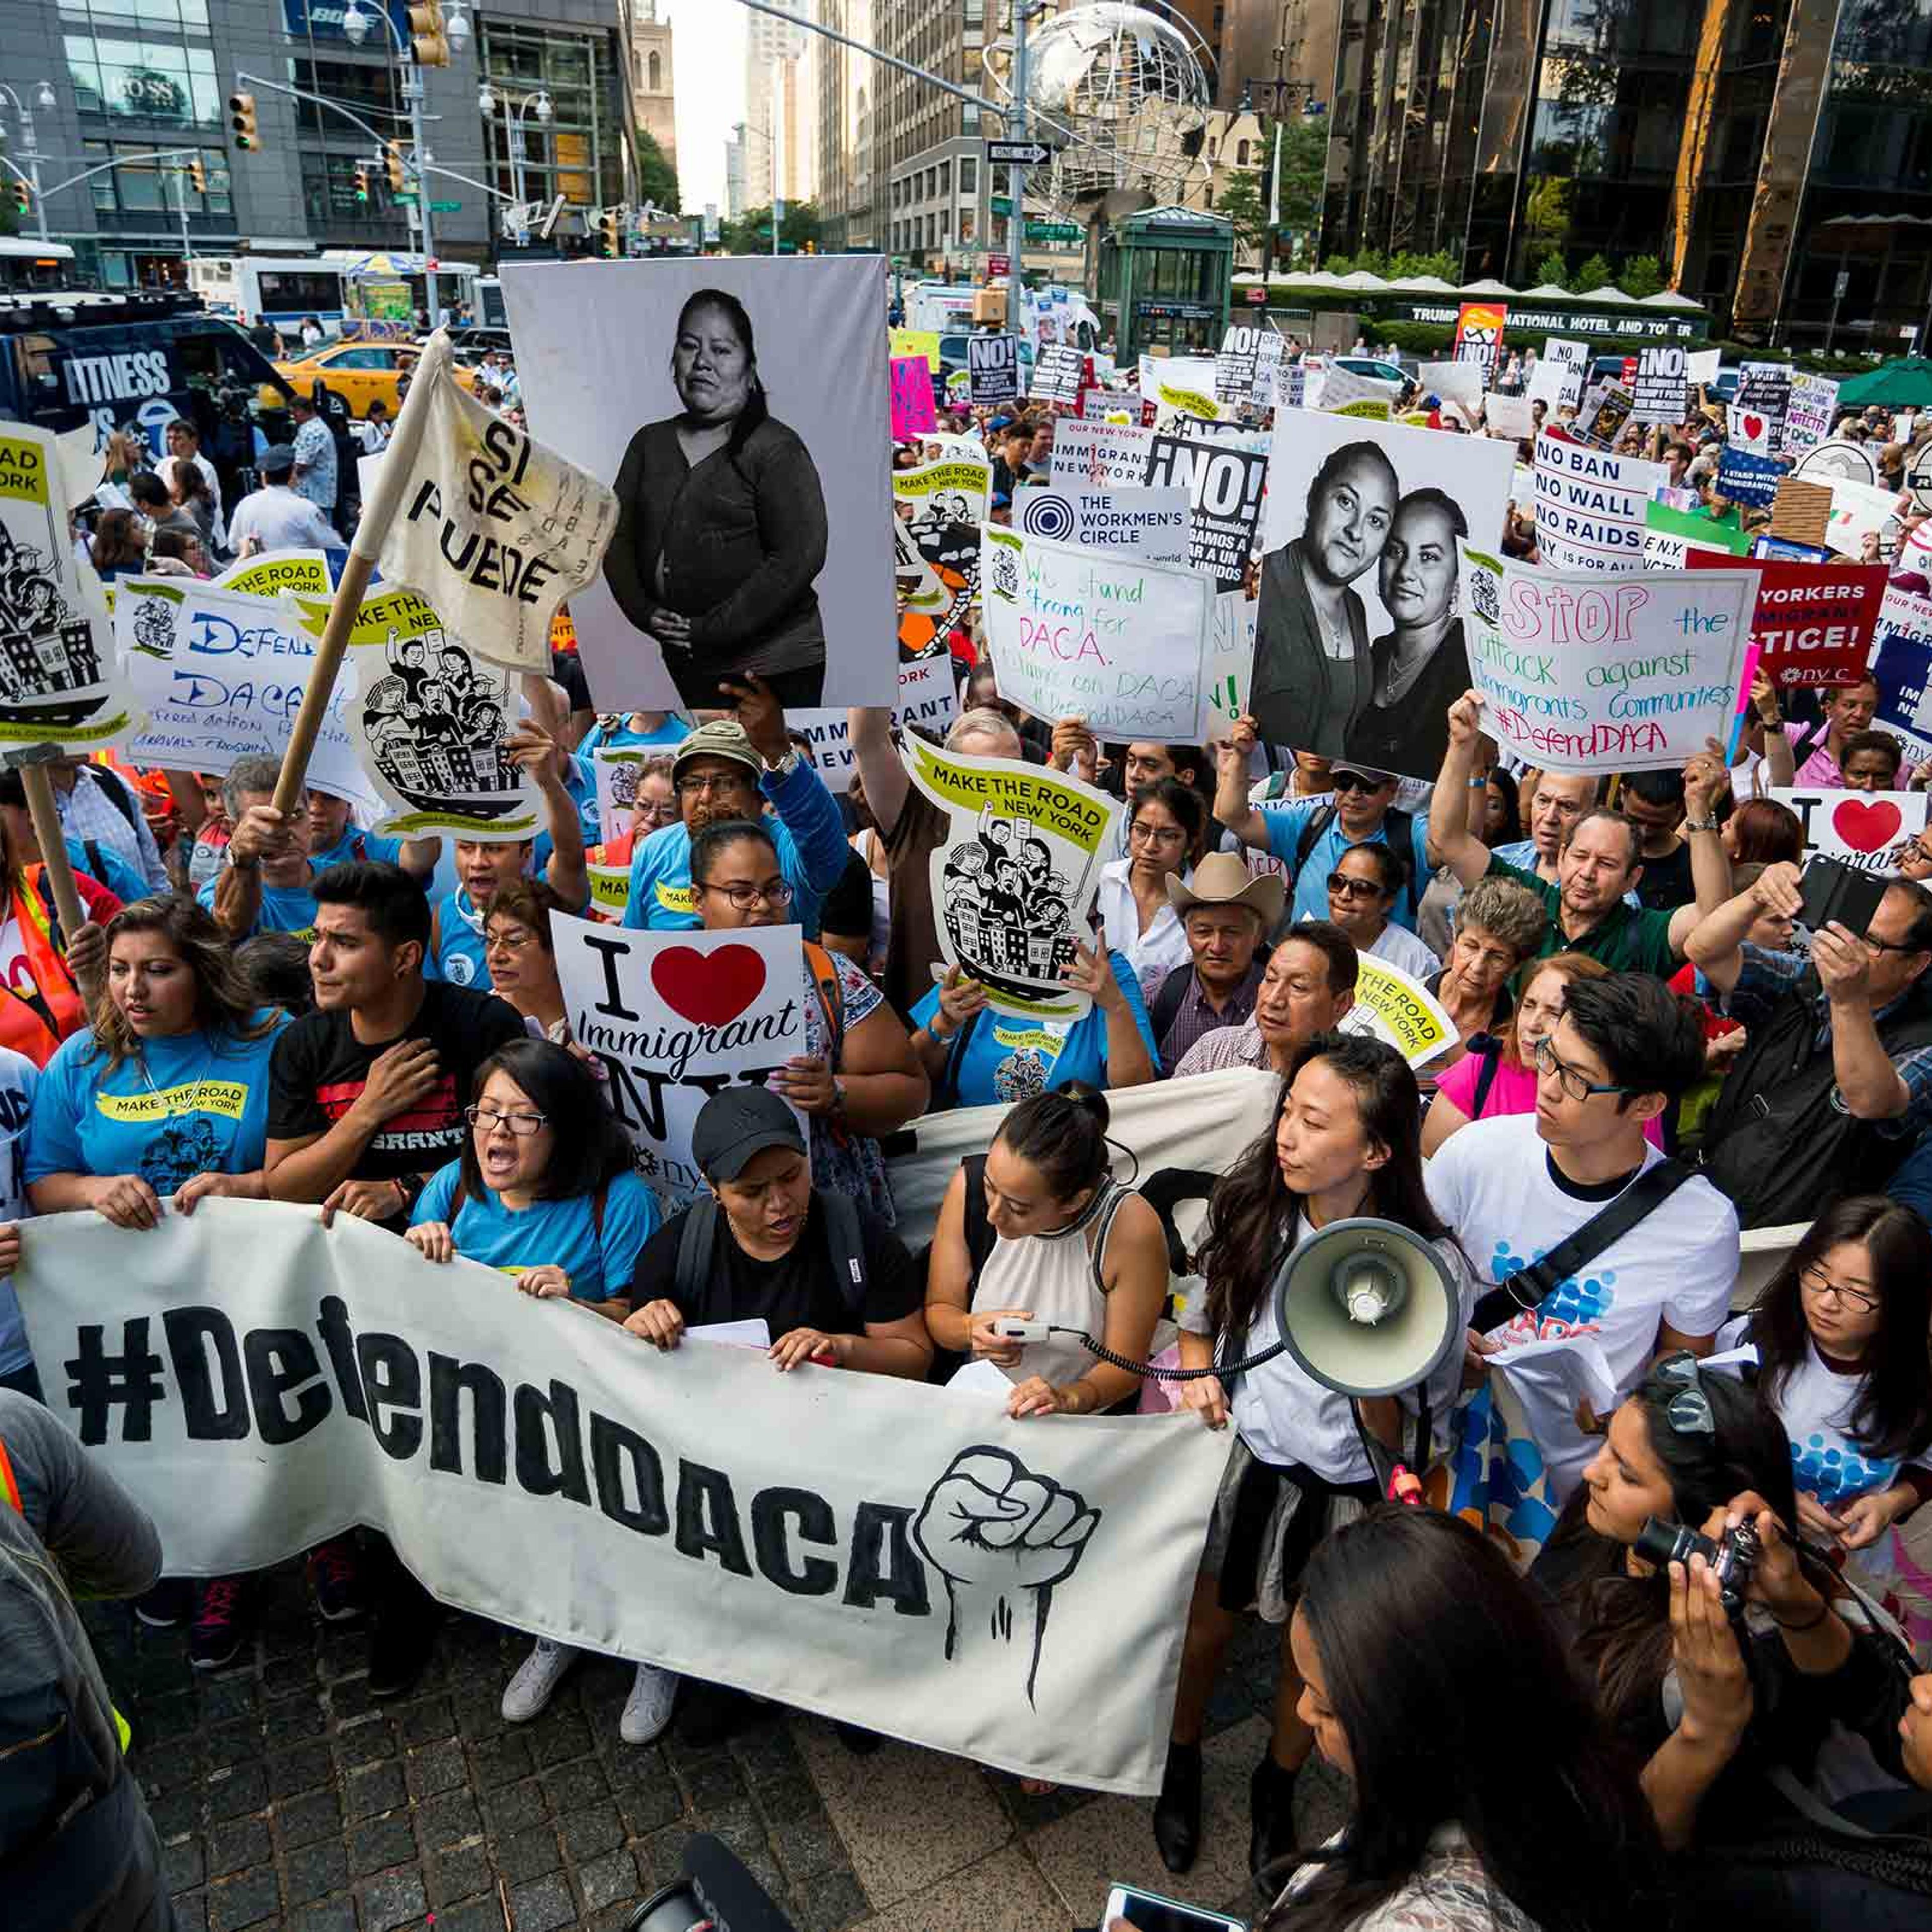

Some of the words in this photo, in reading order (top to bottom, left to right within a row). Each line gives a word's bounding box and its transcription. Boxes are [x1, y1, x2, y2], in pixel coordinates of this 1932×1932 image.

[311, 6, 382, 29] BOE
[1412, 307, 1458, 321] TRUMP
[1505, 312, 1565, 330] NATIONAL
[1570, 317, 1610, 331] HOTEL
[1616, 320, 1643, 334] AND
[1649, 323, 1692, 337] TOER
[972, 336, 1015, 369] NO!
[1221, 327, 1259, 354] NO!
[1559, 347, 1573, 360] NO
[1639, 347, 1688, 376] ¡NO!
[1069, 424, 1089, 433] OUR
[1092, 426, 1115, 435] NEW
[1119, 429, 1144, 440] YORK
[1734, 411, 1741, 436] I
[0, 448, 38, 469] AD
[484, 421, 531, 486] SI
[1056, 443, 1152, 466] IMMIGRANT
[1537, 441, 1563, 464] NO
[1570, 453, 1620, 478] BAN
[0, 472, 38, 492] ORK
[931, 468, 951, 481] THE
[954, 467, 986, 480] ROAD
[1054, 461, 1091, 474] NEW
[1105, 466, 1148, 483] YORK
[1152, 443, 1265, 520] ¡NO!
[468, 458, 531, 522] SE
[1080, 496, 1111, 509] THE
[1536, 472, 1561, 497] NO
[1568, 484, 1634, 516] WALL
[1080, 512, 1183, 527] WORKMEN'S
[1536, 503, 1559, 528] NO
[1566, 517, 1640, 547] RAIDS
[407, 479, 559, 604] PUEDE
[1080, 530, 1140, 544] CIRCLE
[1188, 528, 1236, 550] GAMOS
[1237, 537, 1246, 552] A
[1644, 536, 1656, 550] E
[1206, 549, 1217, 560] A
[1219, 551, 1238, 565] UN
[1537, 533, 1556, 557] NY
[1563, 551, 1574, 564] IS
[1578, 557, 1605, 570] FOR
[231, 572, 267, 591] THE
[268, 565, 320, 581] ROAD
[258, 586, 279, 597] EW
[1760, 585, 1865, 603] YORKERS
[1887, 594, 1909, 608] OUR
[388, 596, 432, 616] TH
[1760, 606, 1861, 623] MIGRANT
[1674, 606, 1729, 635] the
[1019, 616, 1114, 666] DACA.
[1761, 626, 1860, 654] TICE!
[898, 666, 930, 685] ORK
[1585, 651, 1696, 691] against
[169, 670, 304, 718] DACA
[1495, 704, 1667, 760] #DefendDACA
[933, 764, 988, 793] MAKE
[990, 779, 1031, 798] THE
[1036, 786, 1101, 826] ROAD
[1003, 799, 1044, 818] NEW
[1049, 811, 1096, 843] YORK
[1792, 797, 1822, 850] I
[600, 881, 629, 895] MA
[584, 934, 639, 1022] I
[1360, 989, 1394, 1013] NEW
[1393, 1012, 1422, 1048] YORK
[1362, 971, 1397, 996] THE
[1395, 993, 1436, 1040] ROAD
[577, 998, 798, 1081] Immigrant
[115, 1099, 160, 1113] MAKE
[199, 1087, 242, 1101] ROAD
[210, 1099, 240, 1112] YORK
[371, 1126, 466, 1151] GRANT
[65, 1294, 931, 1616] #DefendDACA
